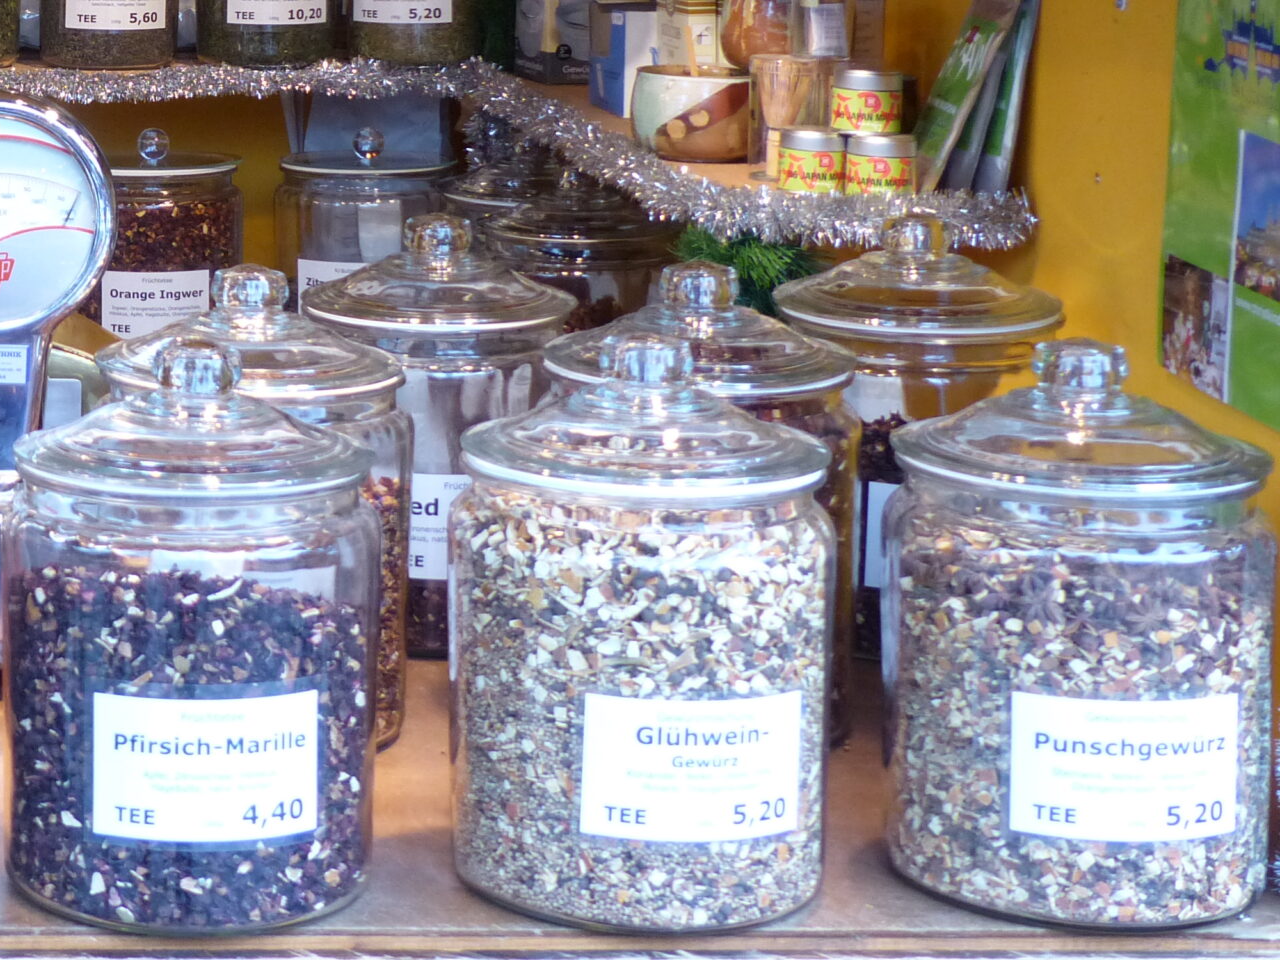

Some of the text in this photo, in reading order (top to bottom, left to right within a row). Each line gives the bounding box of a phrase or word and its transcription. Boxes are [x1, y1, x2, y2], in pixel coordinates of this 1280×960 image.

[76, 11, 158, 27] TEE 5,60
[234, 7, 323, 23] TEE 10,20
[408, 7, 442, 21] 5,20
[109, 287, 204, 302] Orange Ingwer
[110, 323, 131, 334] TEE
[113, 730, 307, 756] Pfirsich-Marille
[635, 724, 769, 747] Glühwein-
[114, 797, 304, 829] TEE 4,40
[603, 797, 786, 826] TEE 5,20
[1032, 799, 1223, 829] TEE 5,20
